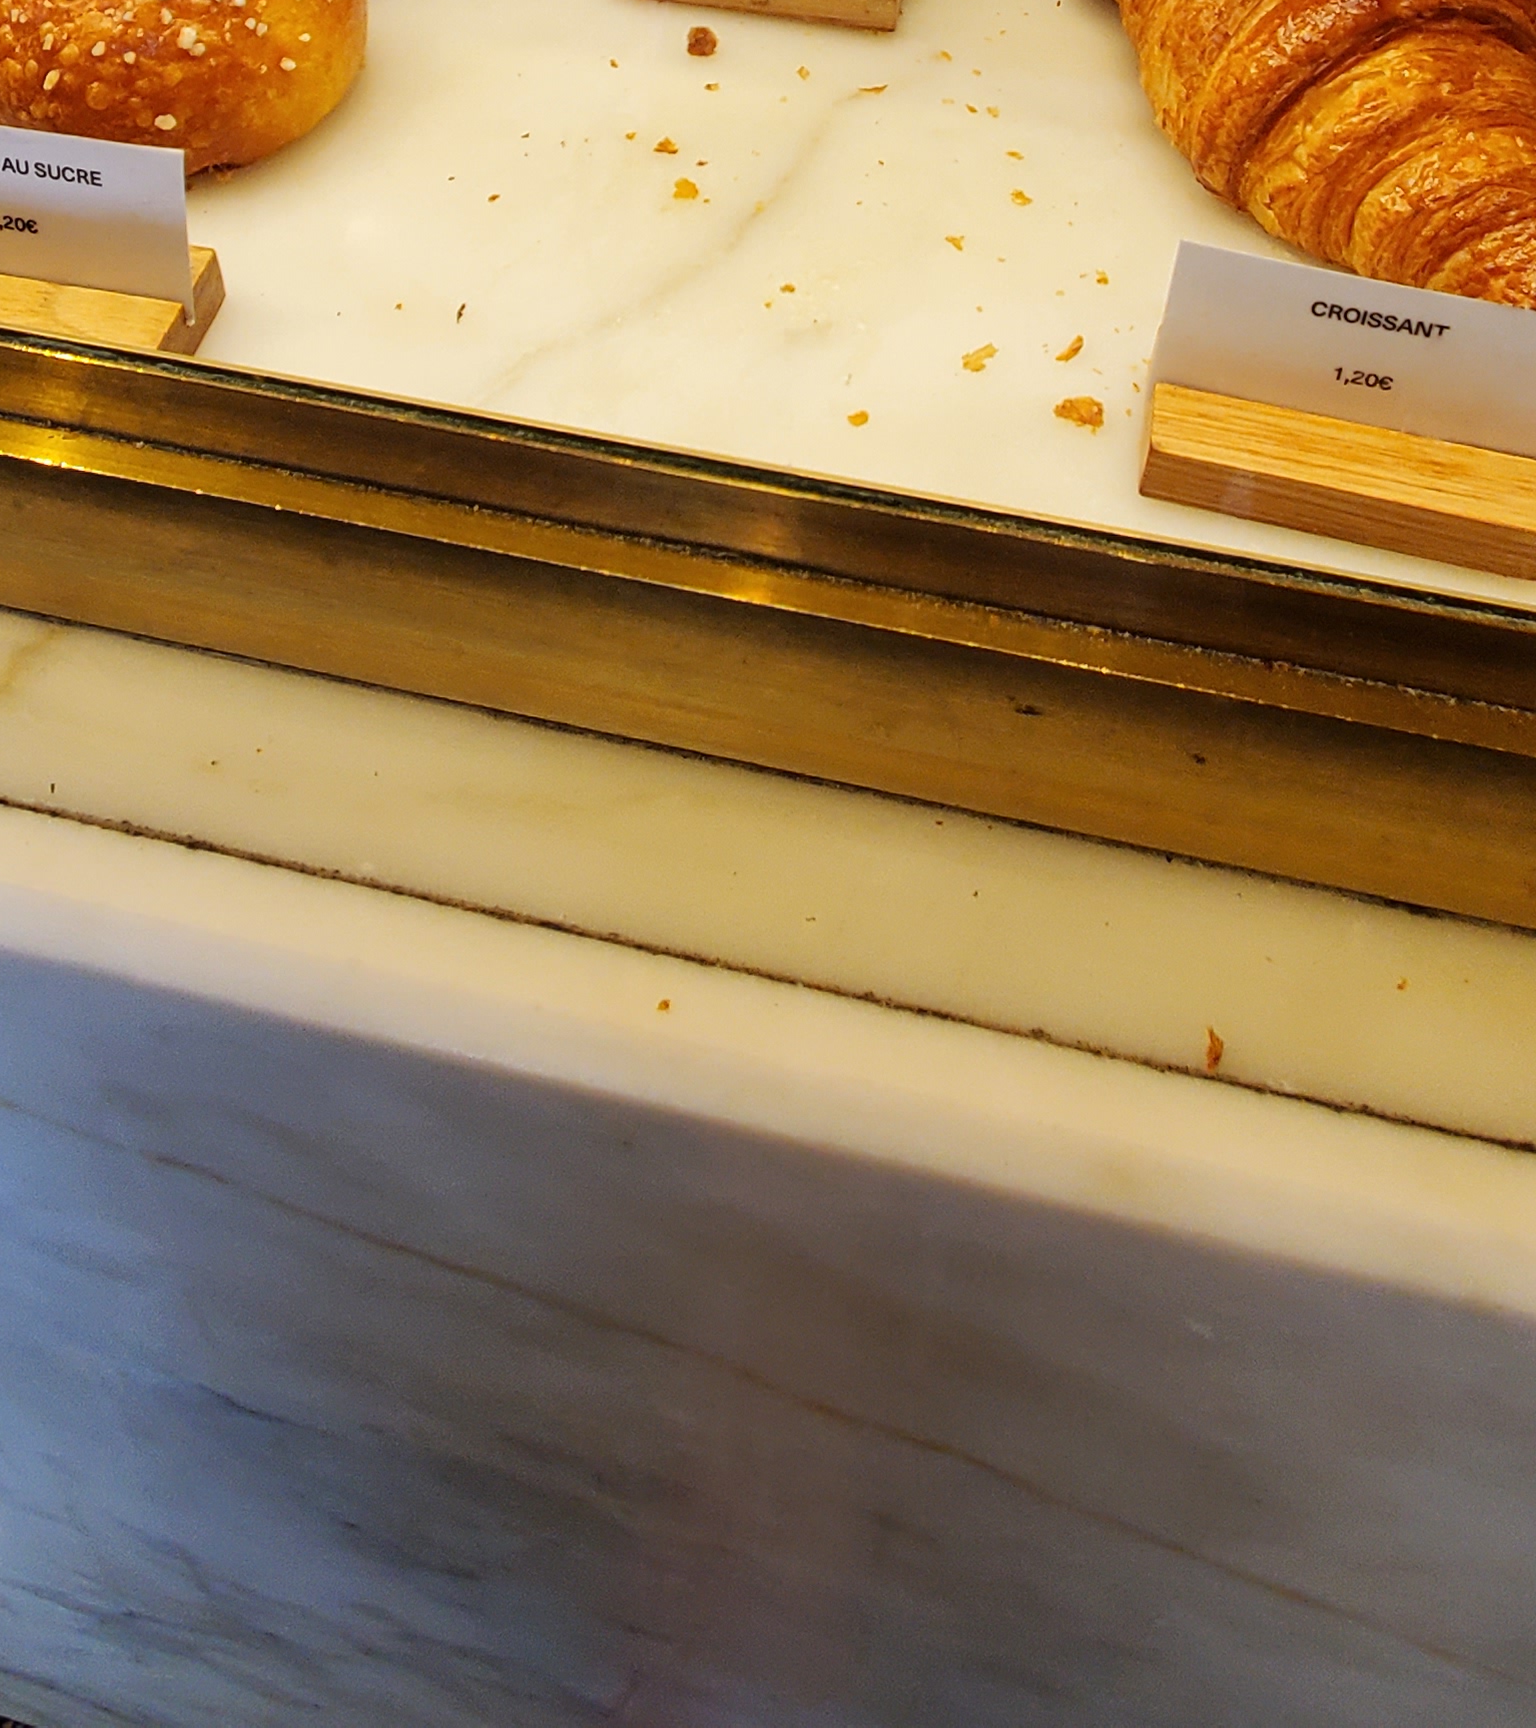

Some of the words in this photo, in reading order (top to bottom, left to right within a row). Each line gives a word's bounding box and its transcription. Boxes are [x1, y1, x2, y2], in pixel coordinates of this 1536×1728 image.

[1, 157, 30, 176] AU
[33, 162, 104, 188] SUCRE
[1309, 299, 1451, 340] CROISSANT
[1332, 365, 1394, 392] 1,20€
